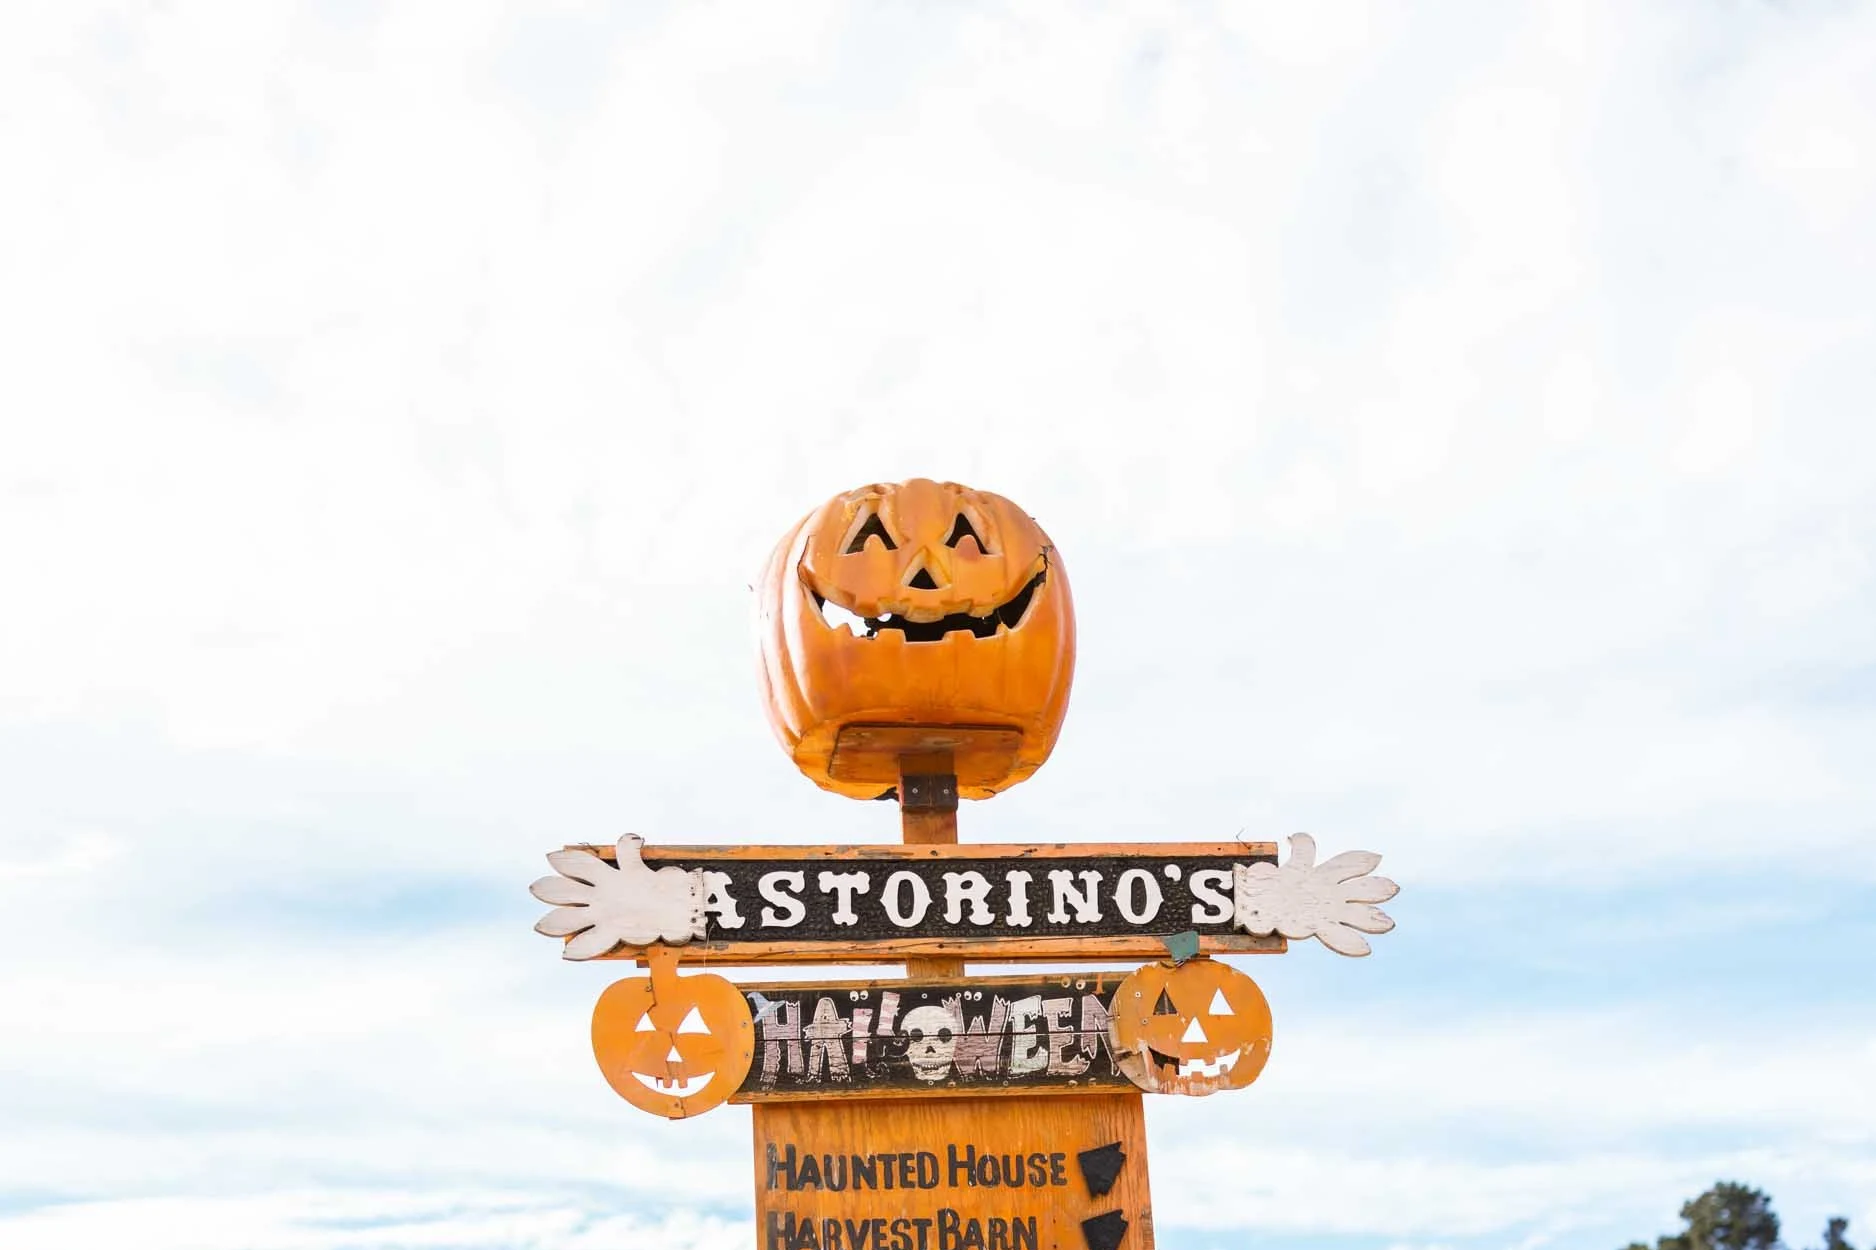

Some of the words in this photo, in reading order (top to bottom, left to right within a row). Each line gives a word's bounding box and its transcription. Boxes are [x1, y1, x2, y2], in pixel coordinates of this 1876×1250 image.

[703, 864, 1235, 929] ASTORINO'S
[766, 1144, 938, 1192] HAUNTED
[947, 1144, 1067, 1188] HOUSE
